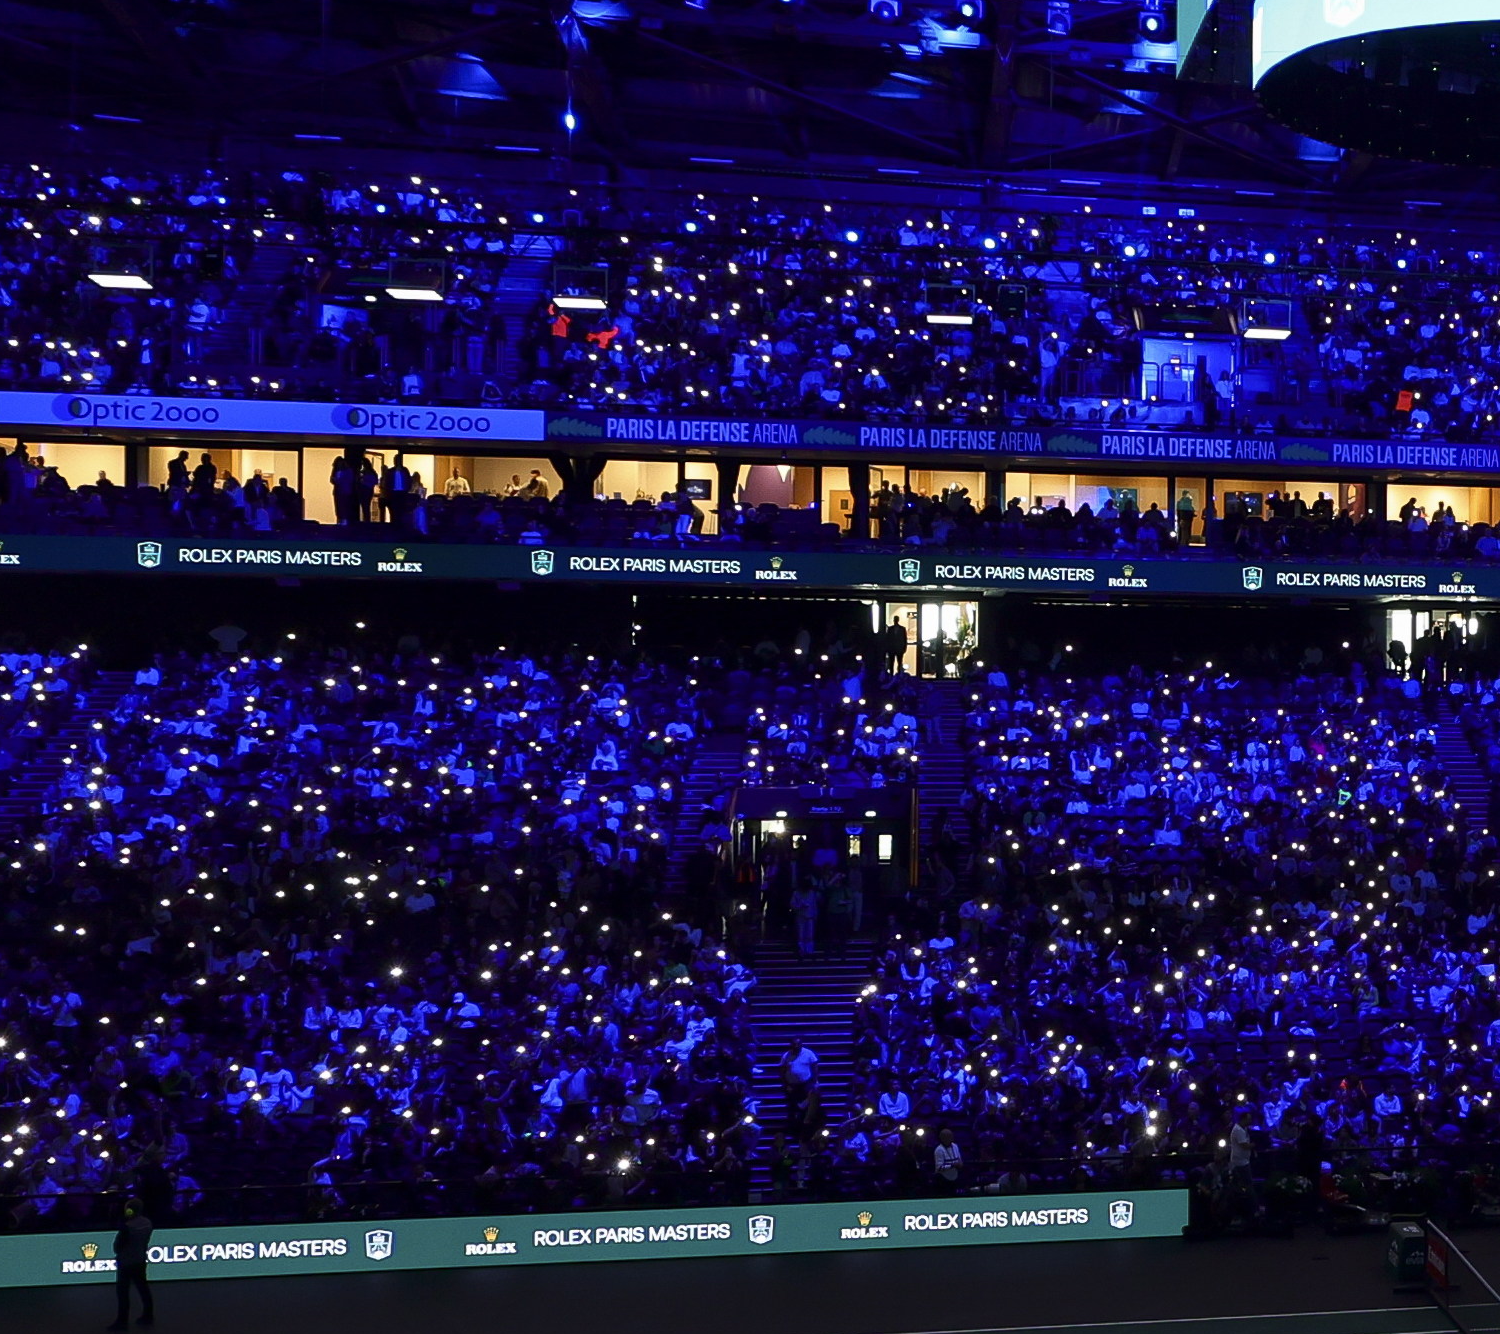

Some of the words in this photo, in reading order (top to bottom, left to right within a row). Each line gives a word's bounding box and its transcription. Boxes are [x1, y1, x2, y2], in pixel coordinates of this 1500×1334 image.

[69, 397, 145, 426] Optic
[152, 403, 219, 423] 2000
[349, 406, 421, 434] Optic
[425, 412, 490, 432] 2000
[607, 417, 654, 439] PARIS
[657, 419, 677, 440] LA
[680, 420, 750, 442] DEFENSE
[753, 423, 798, 443] ARENA
[1102, 435, 1145, 455] PARIS
[1148, 436, 1166, 456] LA
[1169, 437, 1232, 458] DEFENSE
[1235, 440, 1276, 459] ARENA
[178, 548, 233, 563] ROLEX
[236, 549, 282, 564] PARIS
[285, 551, 362, 566] MASTERS
[570, 556, 620, 571] ROLEX
[623, 557, 666, 572] PARIS
[669, 559, 741, 574] MASTERS
[377, 562, 423, 572] ROLEX
[755, 570, 797, 580] ROLEX
[935, 564, 982, 579] ROLEX
[985, 566, 1025, 580] PARIS
[1028, 567, 1095, 581] MASTERS
[1108, 577, 1148, 588] ROLEX
[904, 1213, 959, 1230] ROLEX
[962, 1211, 1008, 1228] PARIS
[1011, 1208, 1089, 1226] MASTERS
[534, 1229, 592, 1246] ROLEX
[595, 1226, 645, 1243] PARIS
[648, 1223, 731, 1241] MASTERS
[841, 1227, 888, 1238] ROLEX
[145, 1245, 198, 1263] OLEX
[201, 1242, 255, 1260] PARIS
[259, 1239, 347, 1257] MASTERS
[466, 1239, 516, 1255] ROLEX
